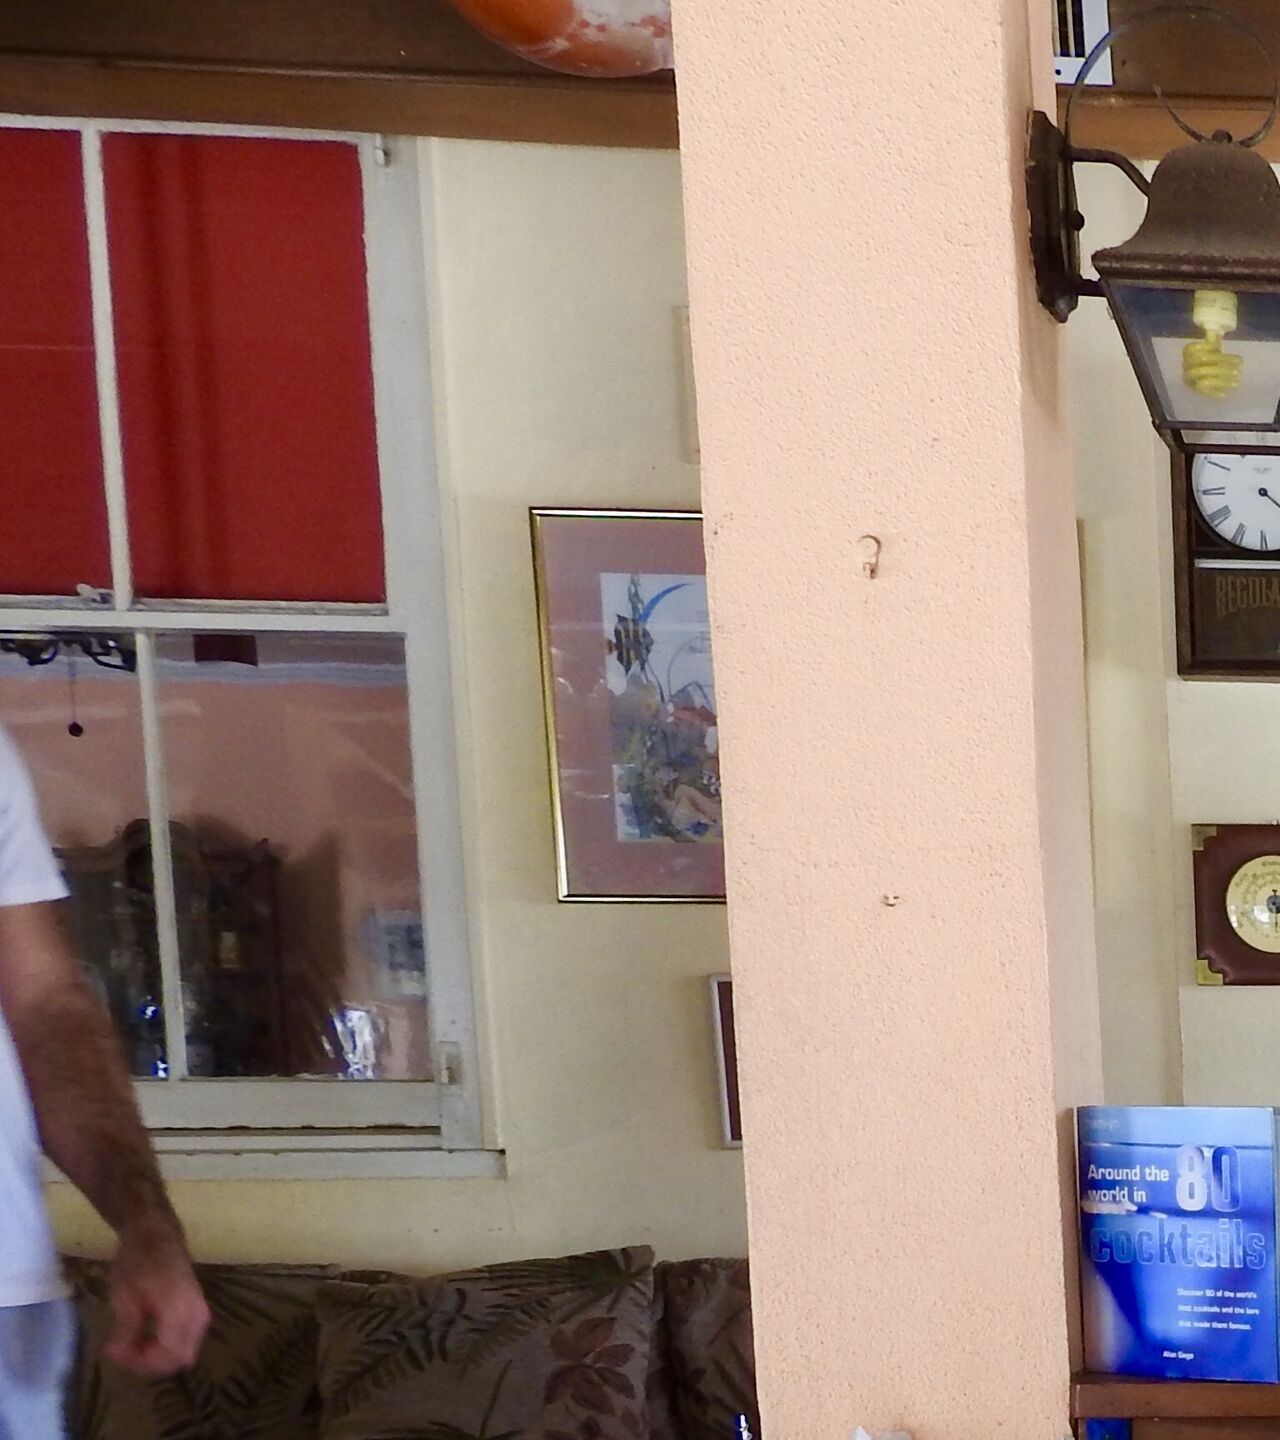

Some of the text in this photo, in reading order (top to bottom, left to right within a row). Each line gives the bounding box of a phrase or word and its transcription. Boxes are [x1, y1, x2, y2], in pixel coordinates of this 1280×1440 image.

[1088, 1164, 1170, 1182] Around the
[1176, 1144, 1242, 1212] 80
[1088, 1186, 1146, 1203] world in
[1090, 1218, 1266, 1270] cocktails
